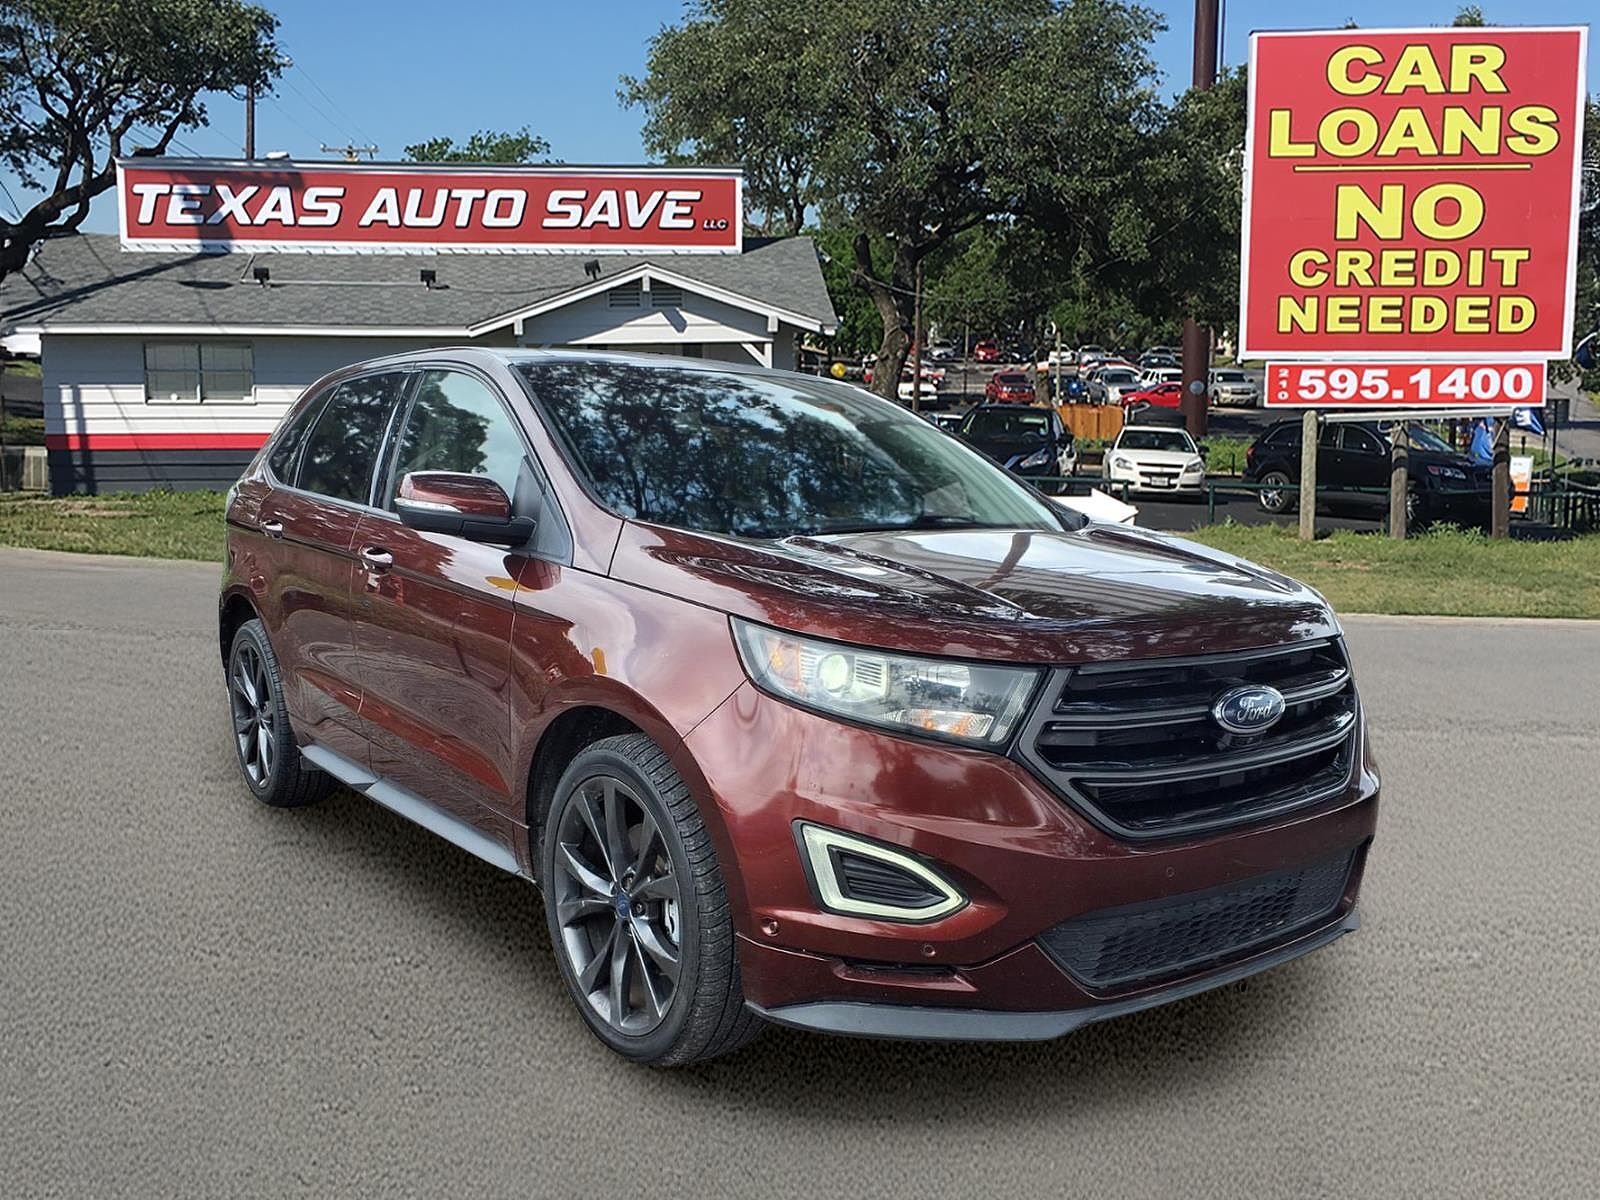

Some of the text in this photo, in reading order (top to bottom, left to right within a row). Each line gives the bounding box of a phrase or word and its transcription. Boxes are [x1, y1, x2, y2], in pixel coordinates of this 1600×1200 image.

[1326, 43, 1509, 95] CAR
[1268, 105, 1560, 158] LOANS
[132, 183, 728, 231] TEXAS AUTO SAVE LLC
[1334, 182, 1485, 241] NO
[1289, 249, 1530, 288] CREDIT
[1277, 295, 1537, 334] NEEDED
[1297, 368, 1533, 400] 595.1400
[1237, 695, 1273, 722] Ford
